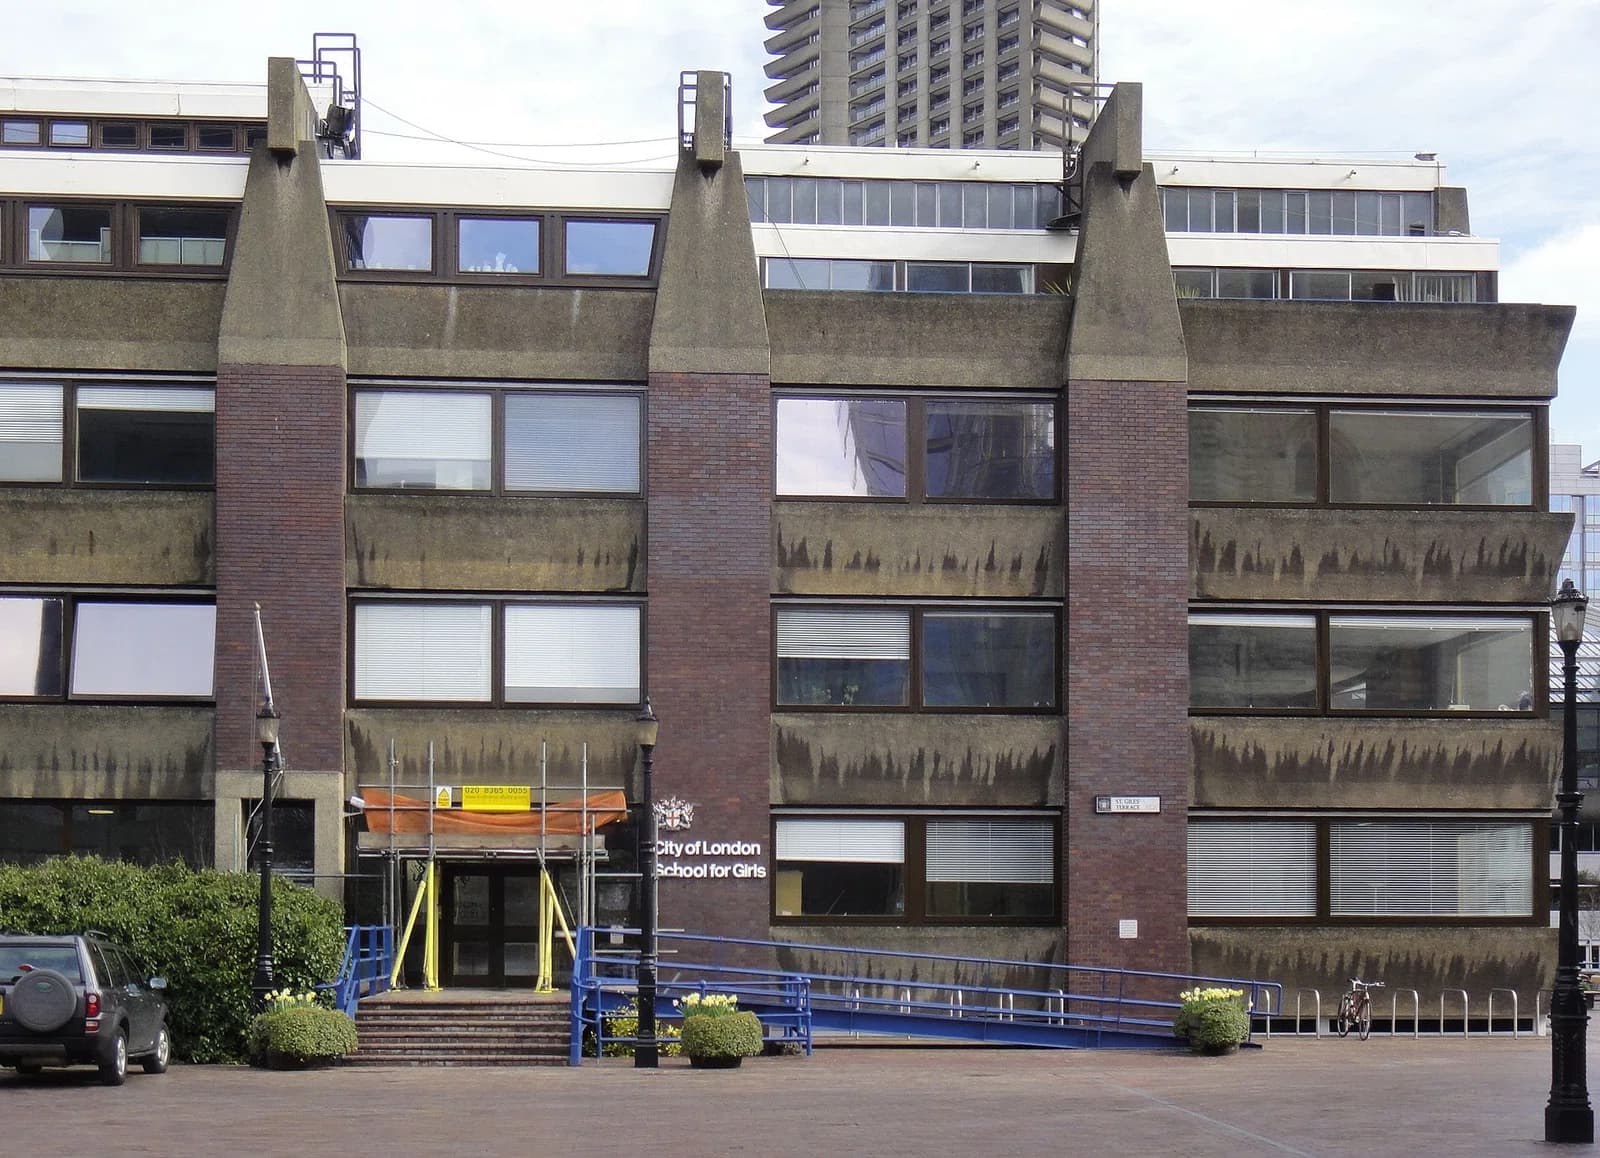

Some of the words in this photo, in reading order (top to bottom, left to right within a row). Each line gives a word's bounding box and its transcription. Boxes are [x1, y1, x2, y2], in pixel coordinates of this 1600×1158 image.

[656, 840, 684, 857] City
[684, 841, 701, 855] of
[702, 840, 761, 855] London
[656, 862, 708, 878] School
[709, 863, 731, 878] for
[732, 863, 767, 878] Girls
